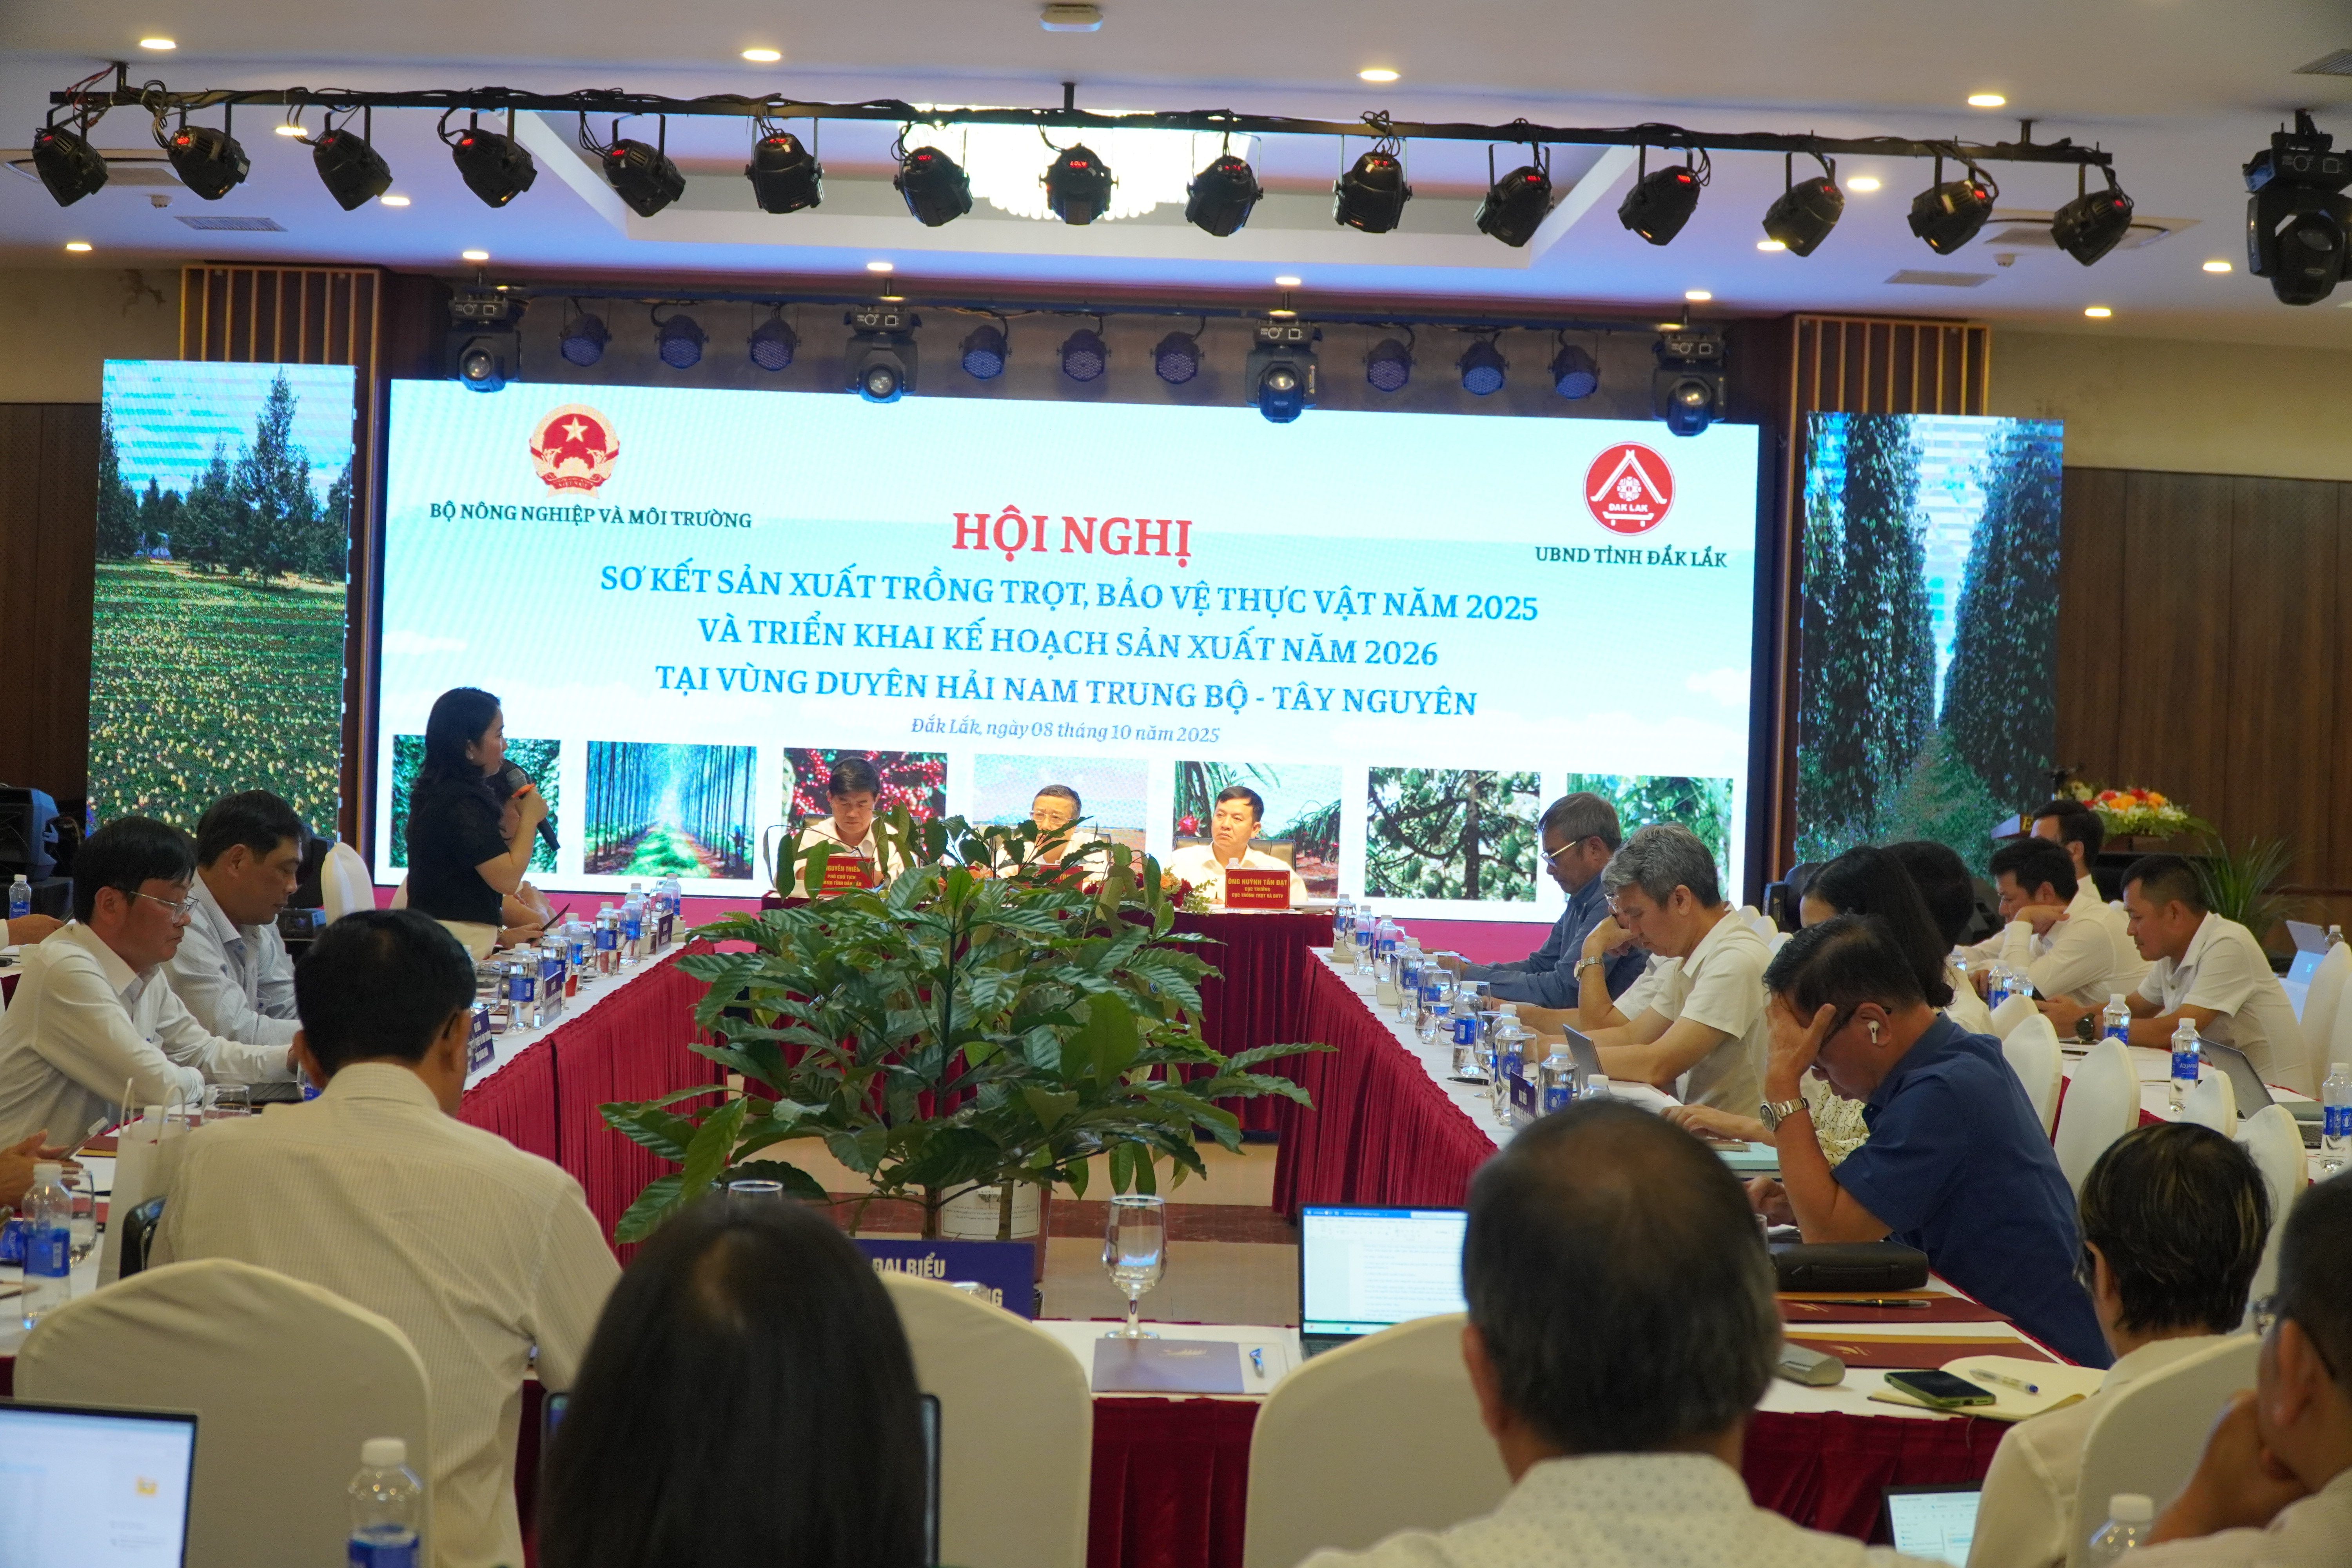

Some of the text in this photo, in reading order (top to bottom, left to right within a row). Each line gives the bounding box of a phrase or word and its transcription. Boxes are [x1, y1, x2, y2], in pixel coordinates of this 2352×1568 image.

[430, 501, 752, 528] BỘ NÔNG NGHIỆP VÀ MÔI TRƯỜNG
[953, 505, 1192, 568] HỘI NGHỊ
[1535, 545, 1728, 568] UBND TỈNH ĐẮK LẮK
[601, 558, 1538, 621] SƠ KẾT SẢN XUẤT TRỒNG TRỌT, BẢO VỆ THỰC VẬT NĂM 2025
[698, 612, 1438, 666] VÀ TRIỂN KHAI KẾ HOẠCH SẢN XUẤT NĂM 2026
[656, 666, 709, 696] TẠI
[717, 662, 808, 694] VÙNG
[816, 668, 928, 698] DUYÊN
[937, 670, 995, 700] HẢI
[1004, 678, 1078, 703] NAM
[1087, 681, 1197, 708] TRUNG
[1205, 680, 1248, 715] BỘ
[1273, 681, 1336, 711] TÂY
[1343, 686, 1477, 715] NGUYÊN
[912, 715, 1220, 742] Đắk Lắk, ngày 08 tháng 10 năm 2025
